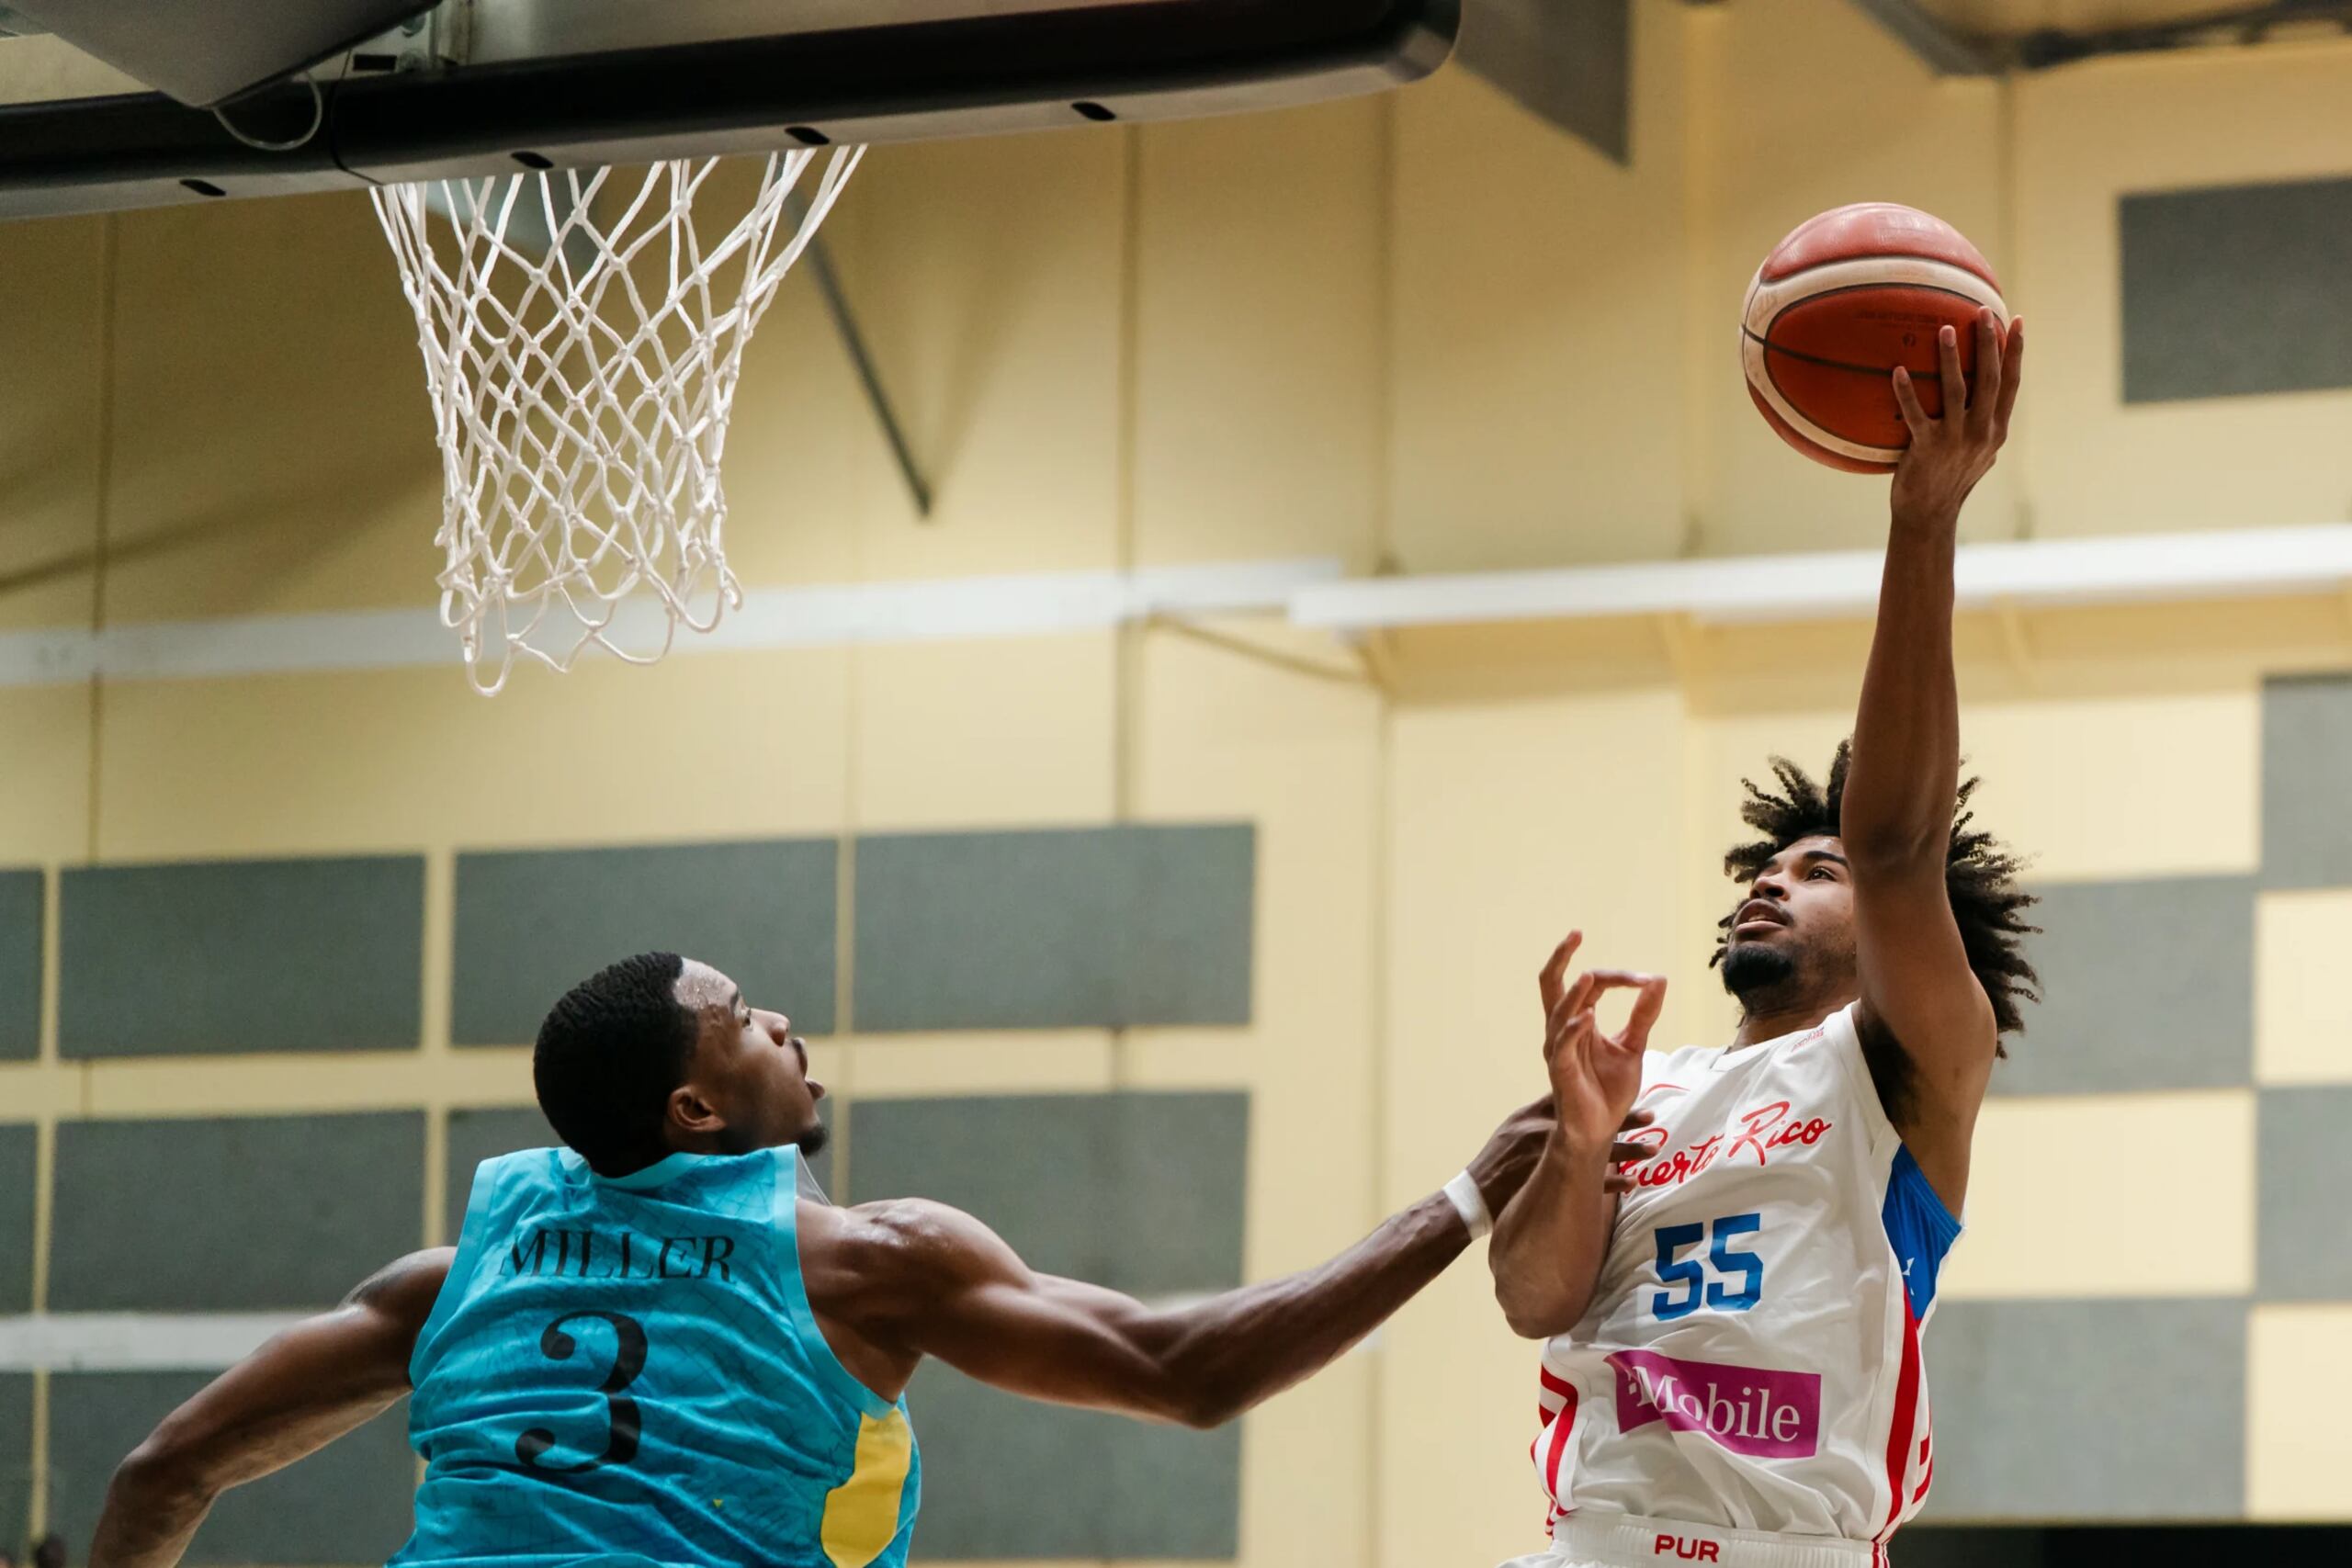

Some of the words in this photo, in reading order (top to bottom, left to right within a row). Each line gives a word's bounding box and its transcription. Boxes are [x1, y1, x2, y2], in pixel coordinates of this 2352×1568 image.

[1728, 1101, 1832, 1167] Rico
[498, 1229, 737, 1283] MILLER
[1652, 1213, 1764, 1321] 55
[515, 1311, 648, 1474] 3
[1655, 1534, 1720, 1563] PUR
